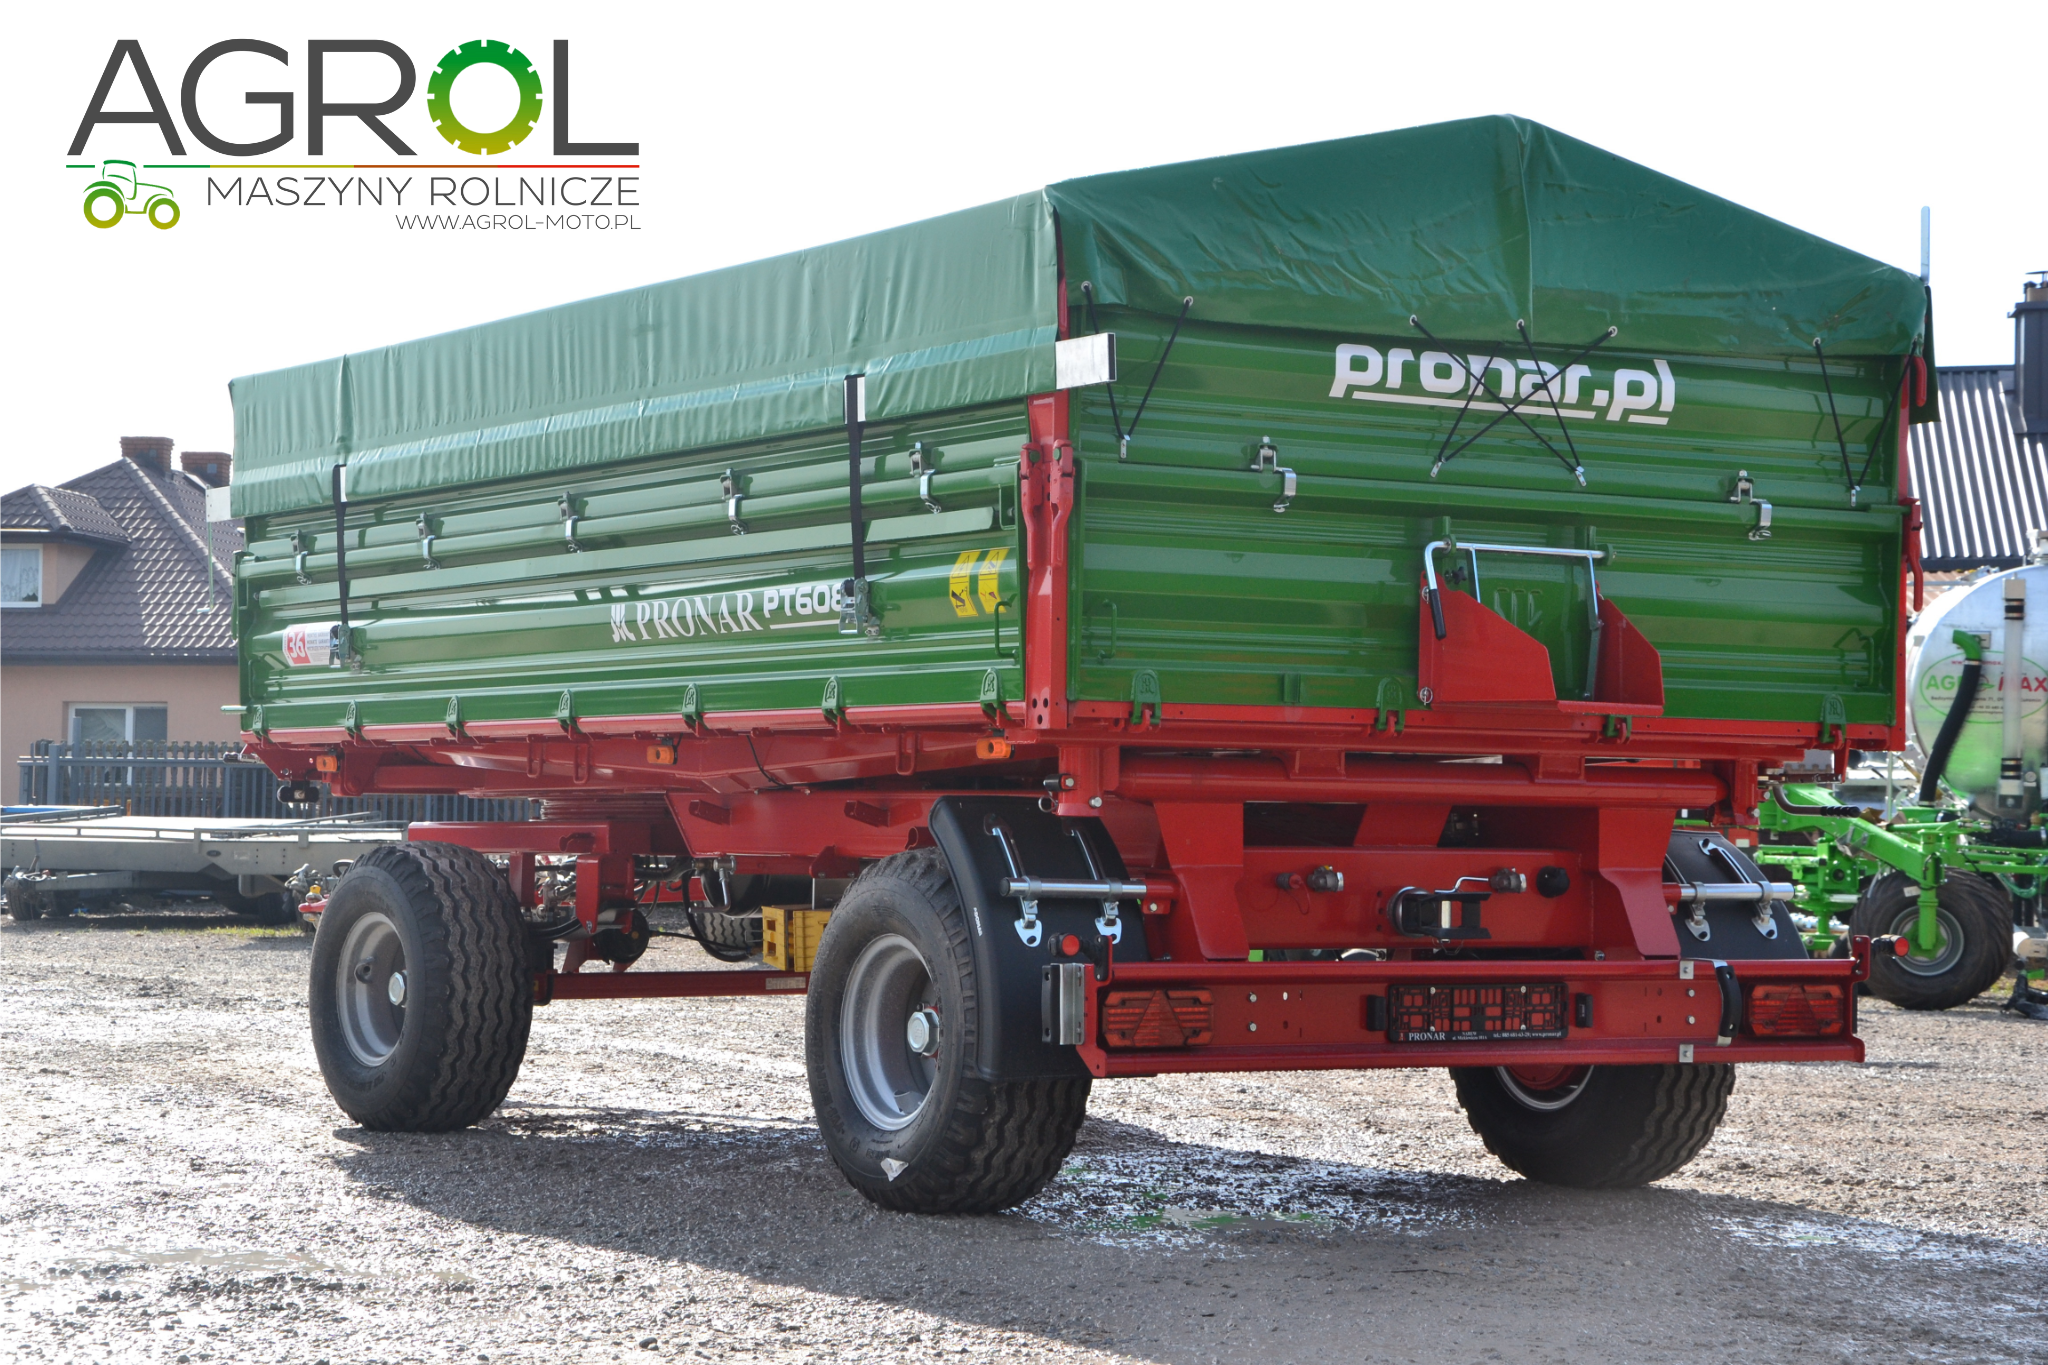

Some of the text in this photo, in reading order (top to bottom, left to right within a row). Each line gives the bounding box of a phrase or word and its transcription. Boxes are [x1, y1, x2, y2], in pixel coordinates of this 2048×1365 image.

[1328, 343, 1676, 422] pronar.pl
[636, 592, 764, 641] PRONAR
[288, 632, 305, 657] 36
[1408, 1031, 1446, 1042] PRONAR
